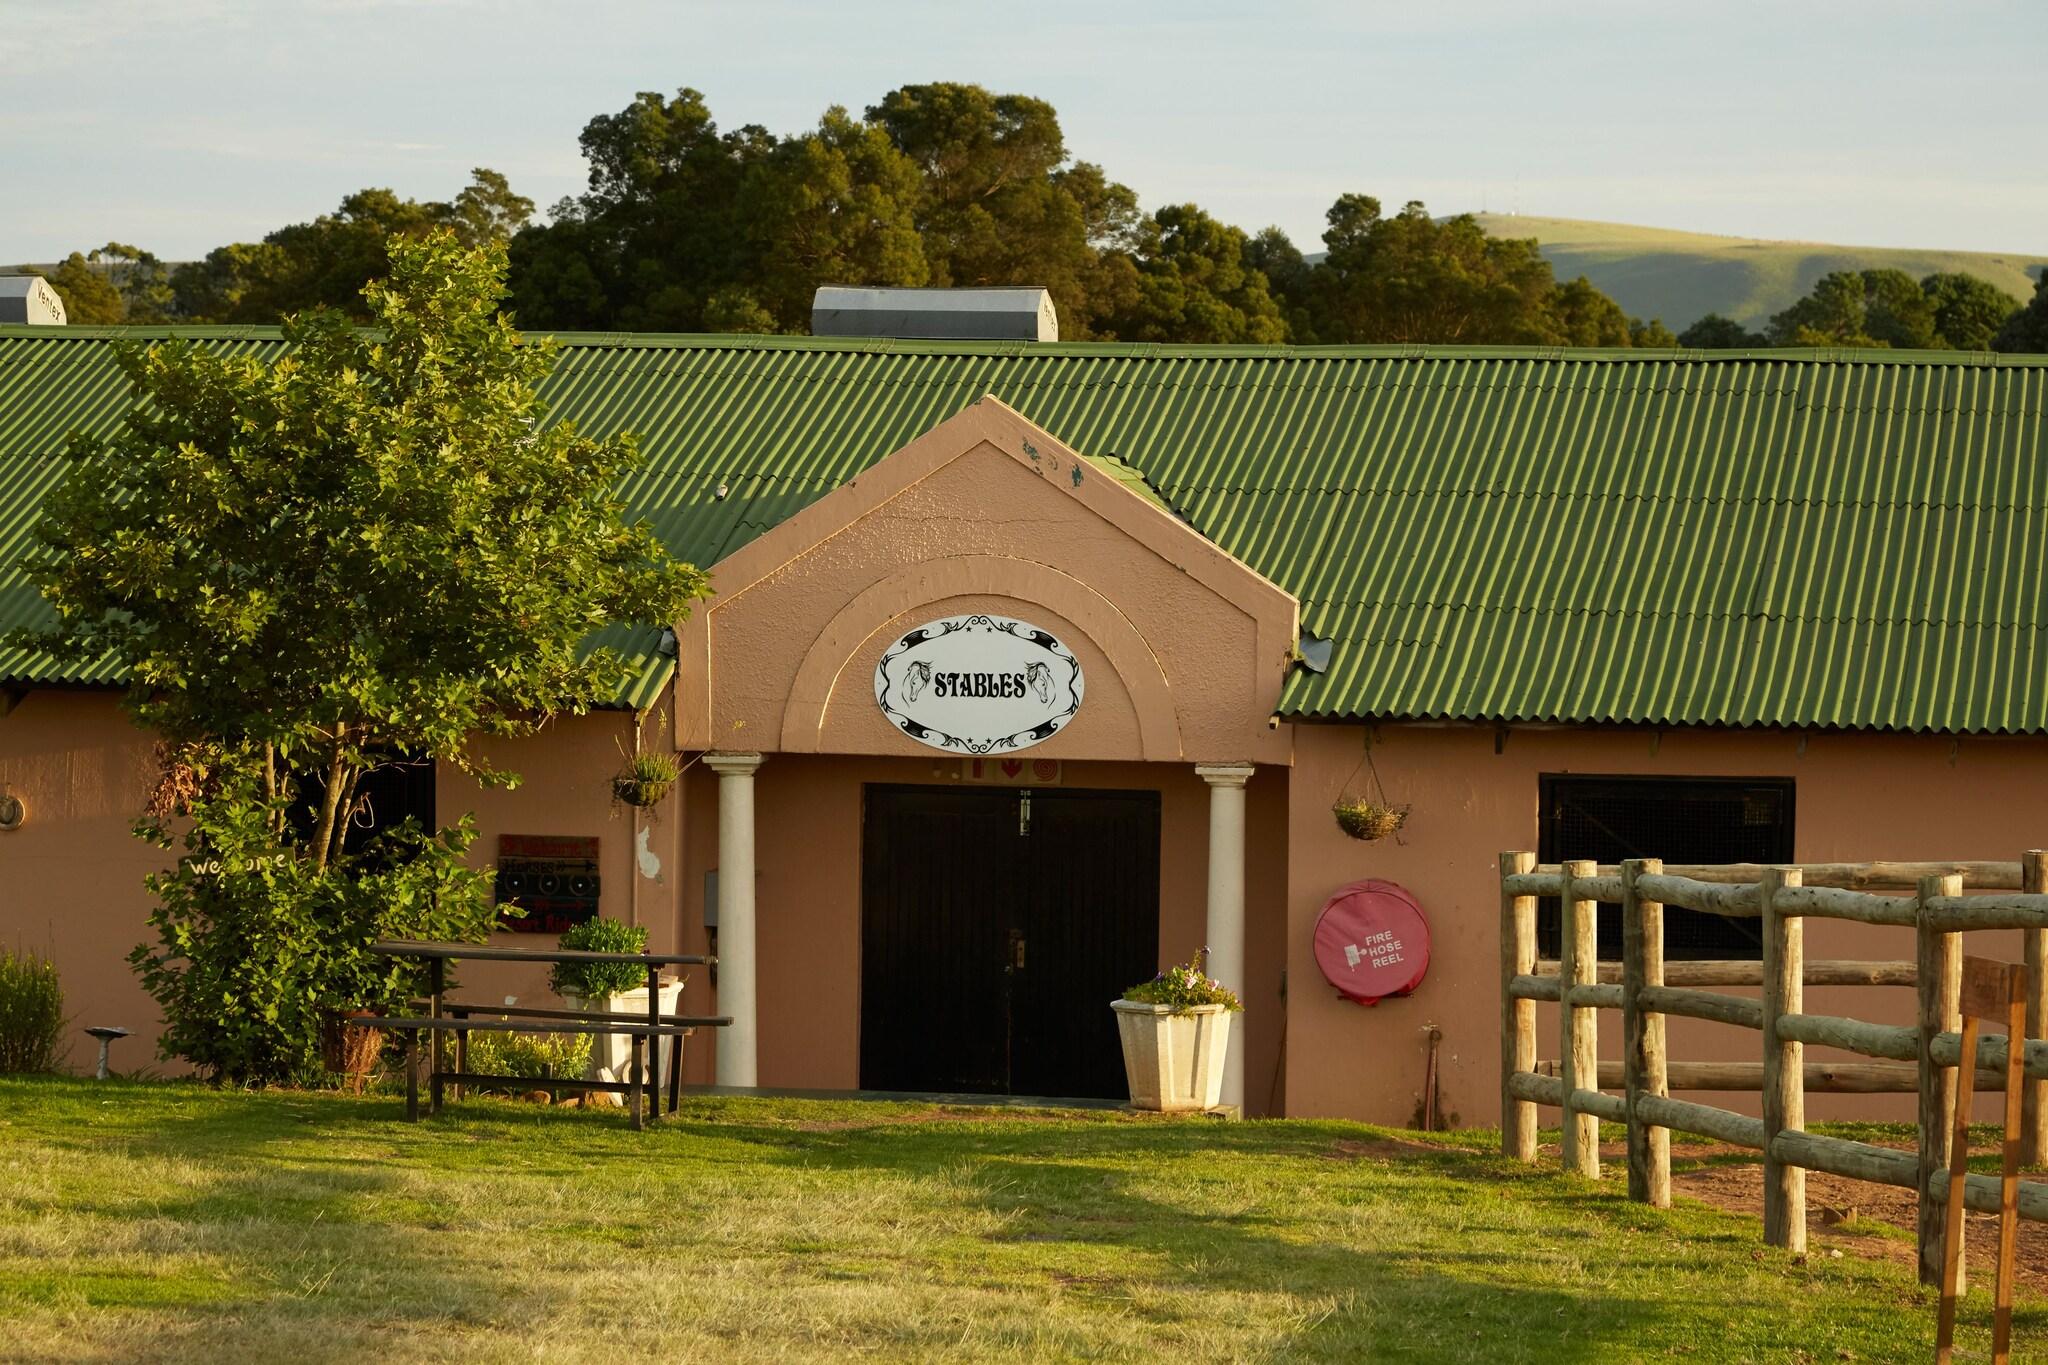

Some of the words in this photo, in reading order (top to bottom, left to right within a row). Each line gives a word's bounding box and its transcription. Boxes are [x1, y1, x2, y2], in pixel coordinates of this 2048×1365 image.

[935, 672, 1026, 698] STABLES
[1365, 930, 1393, 946] FIRE
[1369, 940, 1403, 957] HOSE
[1372, 953, 1404, 968] REEL
